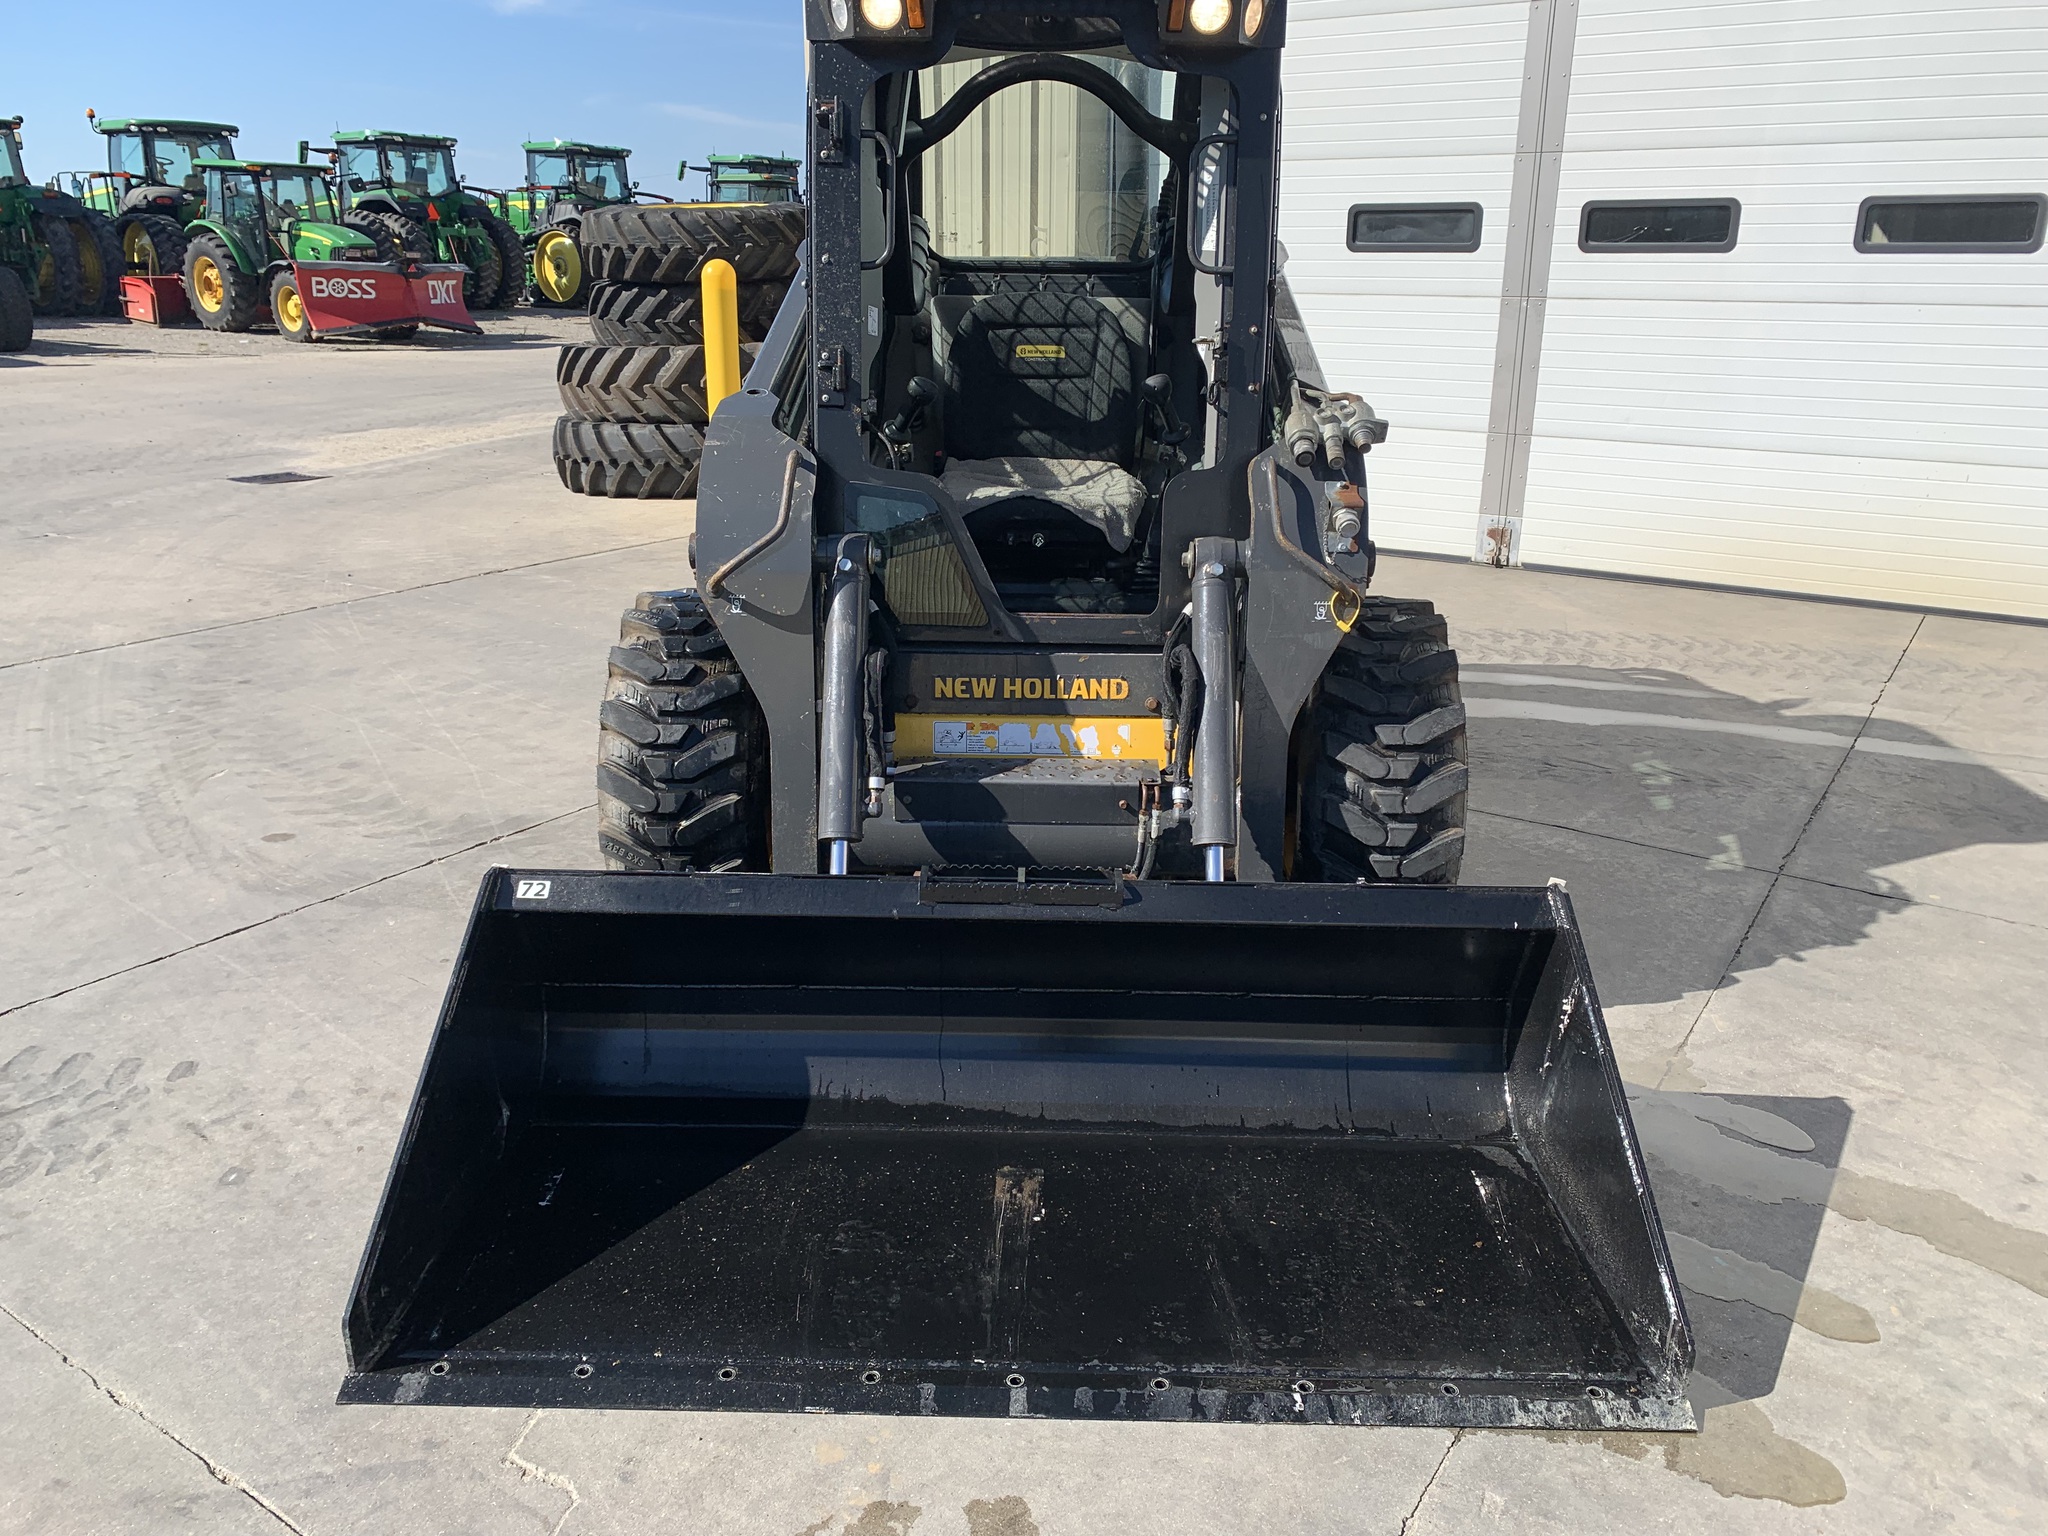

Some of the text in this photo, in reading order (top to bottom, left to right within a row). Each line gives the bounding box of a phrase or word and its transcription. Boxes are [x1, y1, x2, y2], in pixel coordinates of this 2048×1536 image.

[311, 277, 376, 299] BOSS
[427, 280, 458, 304] DXT
[934, 677, 1129, 700] NEW HOLLAND
[626, 852, 646, 867] SKS
[521, 882, 547, 897] 72
